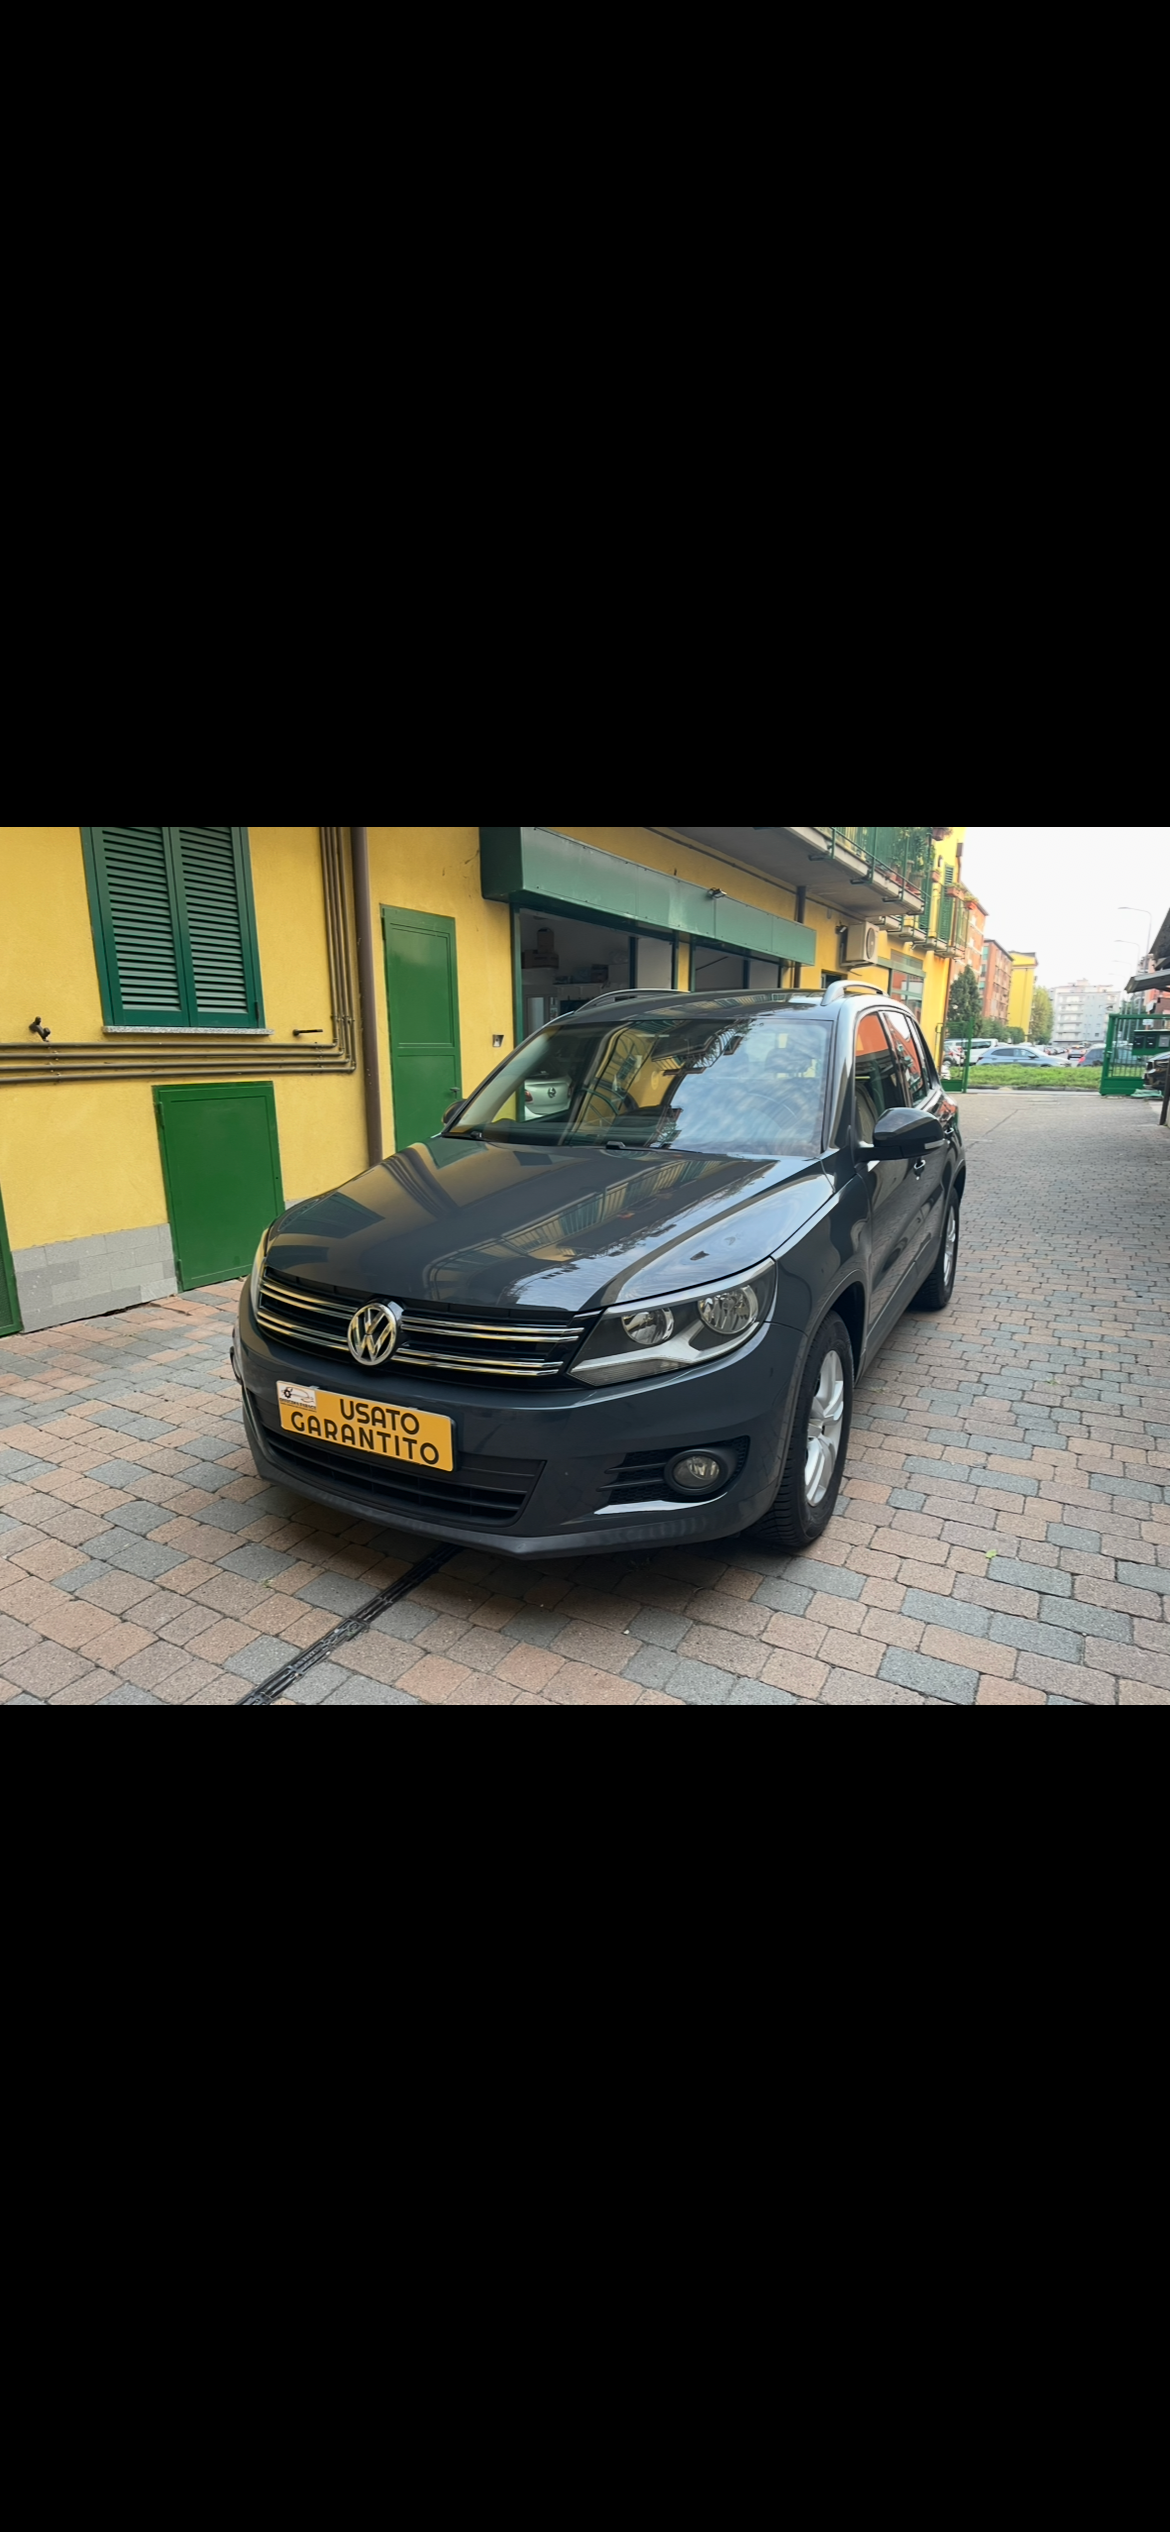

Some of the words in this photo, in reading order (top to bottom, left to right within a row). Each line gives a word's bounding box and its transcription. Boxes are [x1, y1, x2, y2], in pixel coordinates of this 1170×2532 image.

[348, 1303, 396, 1365] VW
[291, 1411, 439, 1465] GARANTITO
[340, 1399, 420, 1435] USATO
